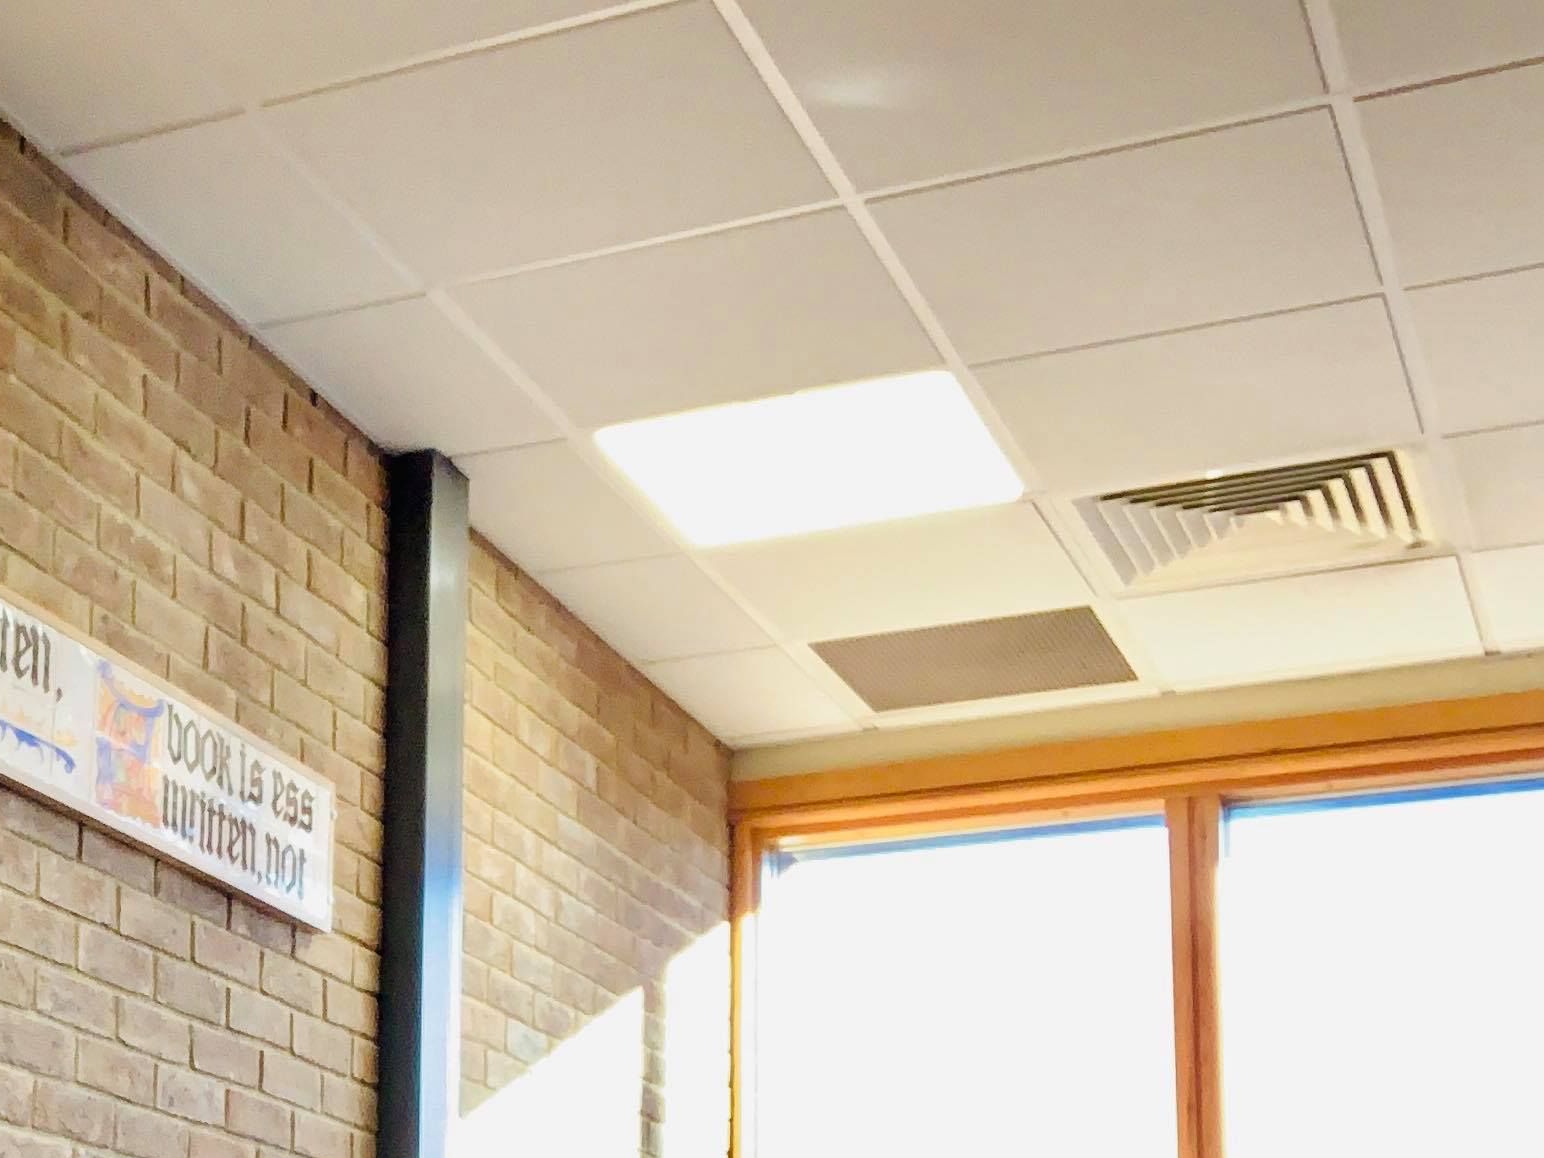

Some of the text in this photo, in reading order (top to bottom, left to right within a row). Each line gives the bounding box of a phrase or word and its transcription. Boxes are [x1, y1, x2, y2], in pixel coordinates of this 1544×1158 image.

[167, 703, 233, 796] book
[239, 744, 265, 805] is
[271, 770, 316, 833] ess
